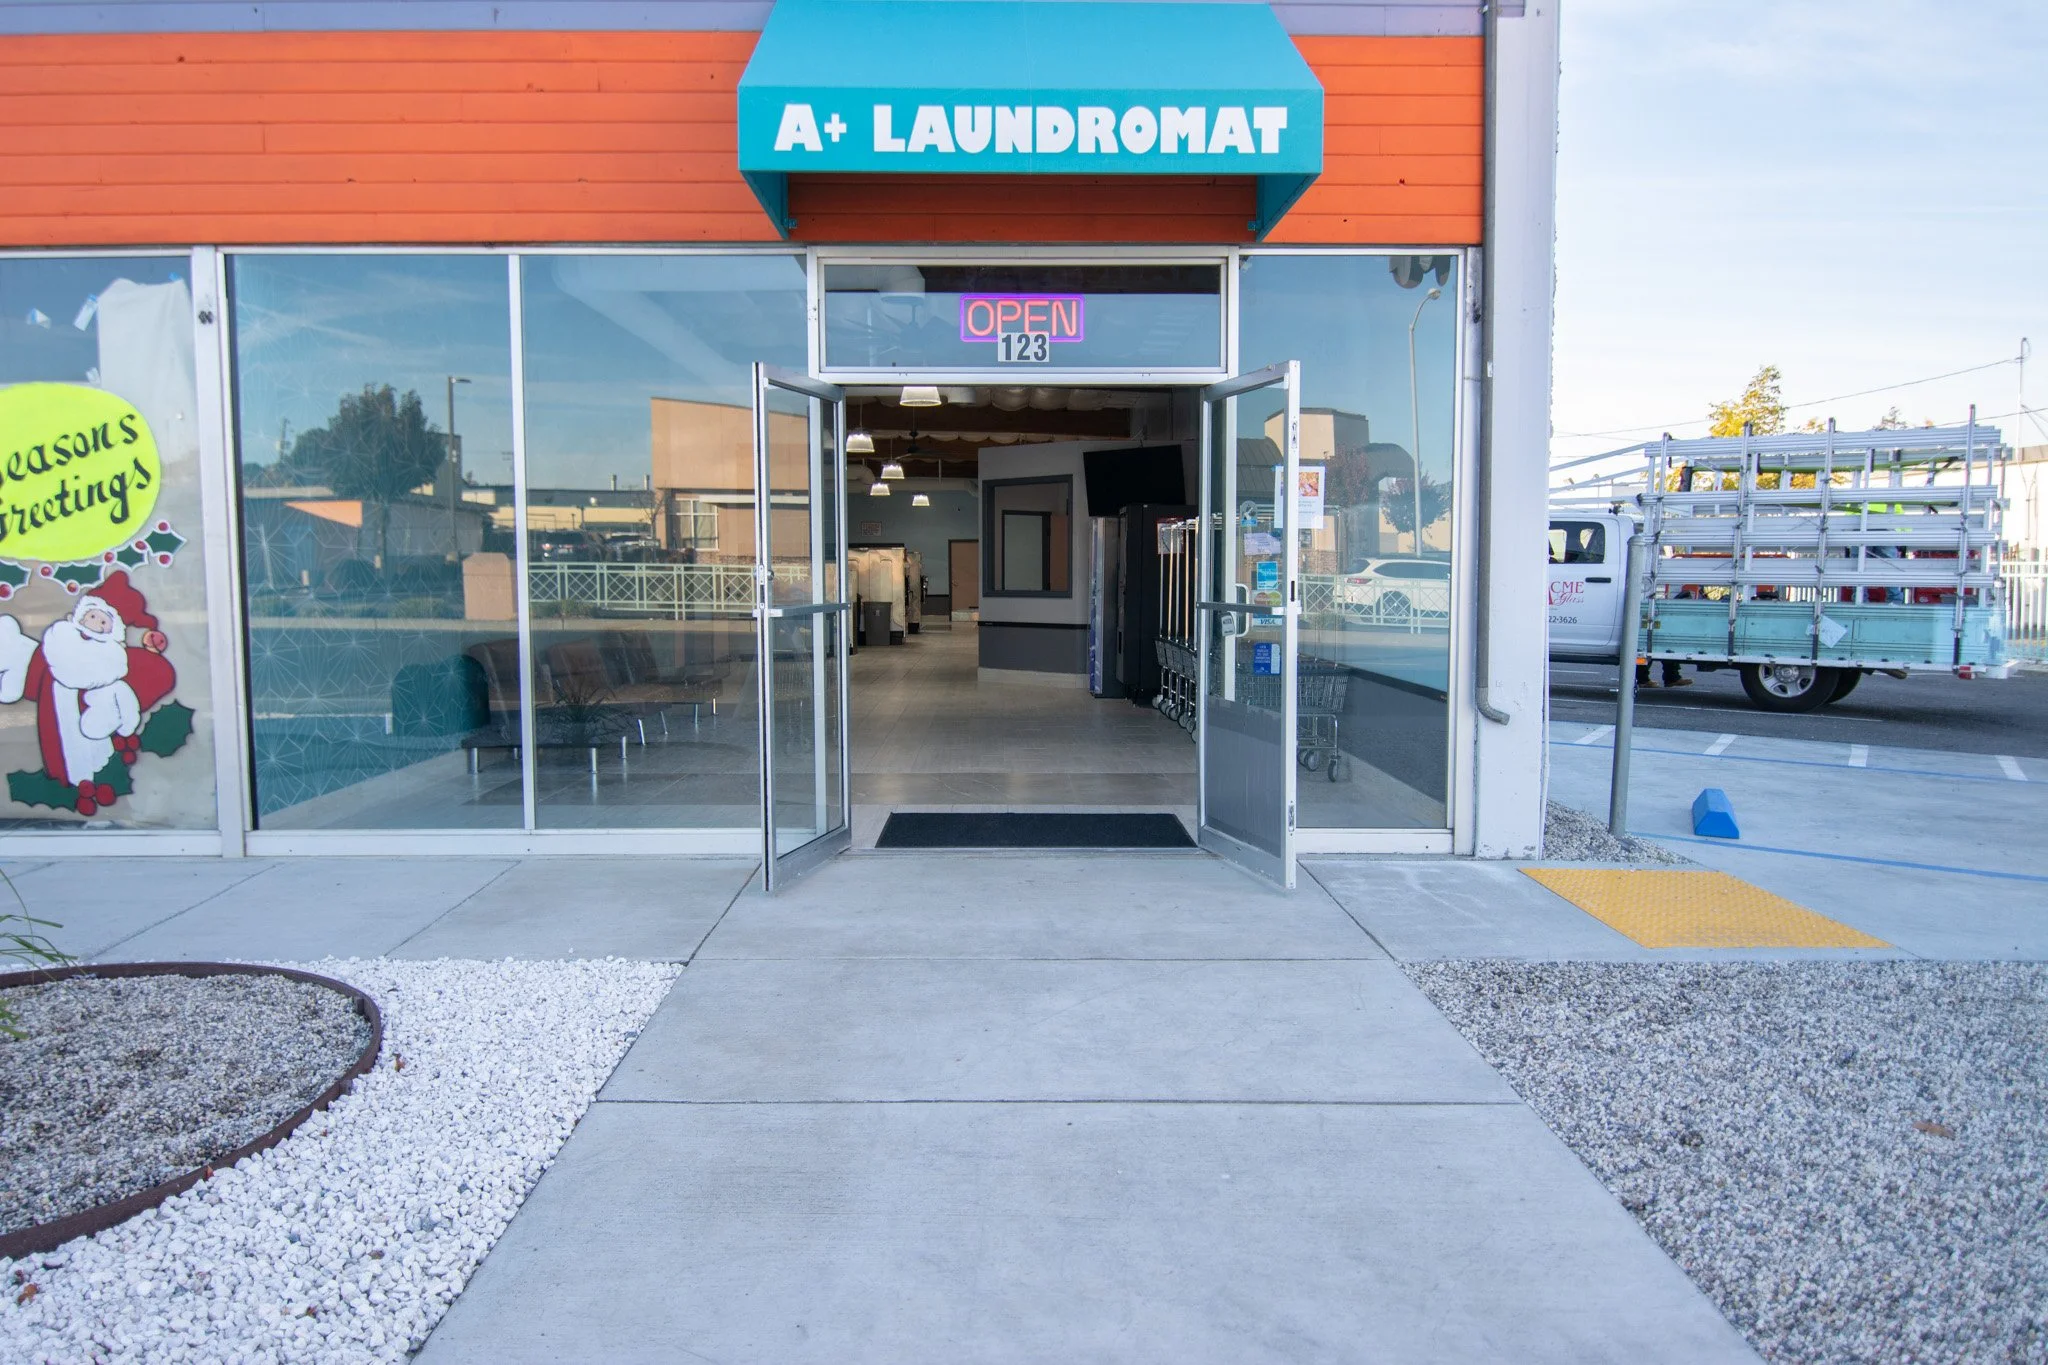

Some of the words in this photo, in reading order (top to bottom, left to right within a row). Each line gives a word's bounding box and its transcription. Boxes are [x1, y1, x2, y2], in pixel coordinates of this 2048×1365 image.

[774, 104, 847, 152] A+
[873, 105, 1288, 154] LAUNDROMAT
[967, 300, 1077, 336] OPEN
[1001, 333, 1048, 361] 123
[0, 414, 138, 487] easons
